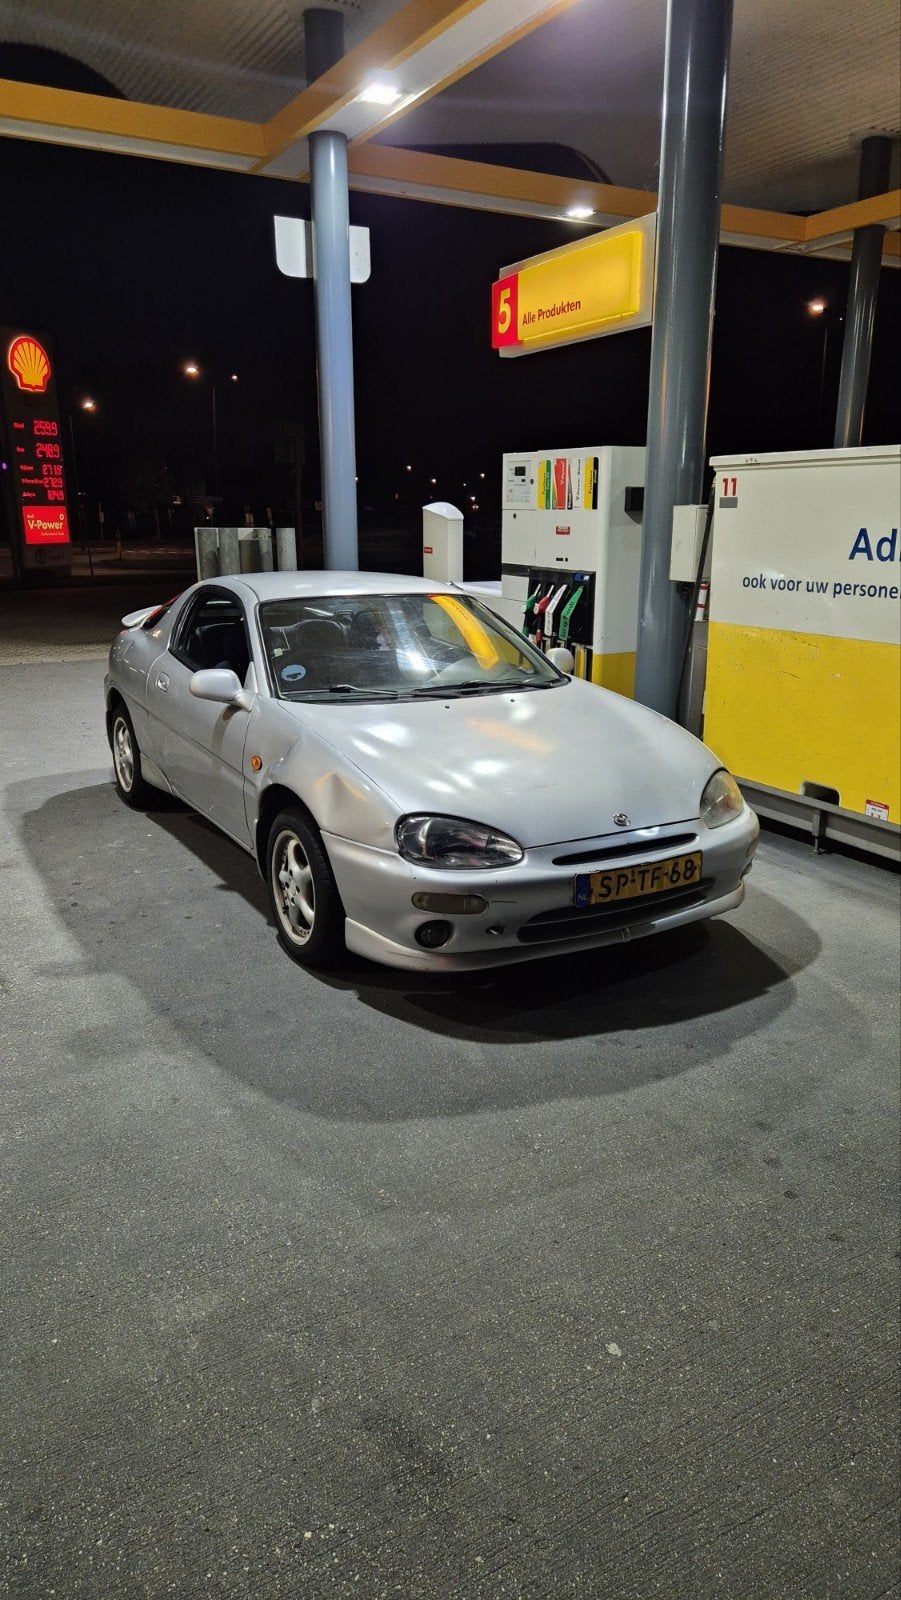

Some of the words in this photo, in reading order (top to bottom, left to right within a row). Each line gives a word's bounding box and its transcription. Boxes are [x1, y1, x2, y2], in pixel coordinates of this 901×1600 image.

[498, 287, 511, 334] 5
[522, 311, 535, 326] Alle
[537, 300, 581, 321] Produkten
[722, 477, 738, 497] 11
[27, 519, 63, 530] V-Power
[848, 528, 901, 562] Ad
[742, 573, 767, 590] ook
[770, 577, 802, 592] voor
[806, 581, 829, 594] uw
[833, 580, 901, 599] persone
